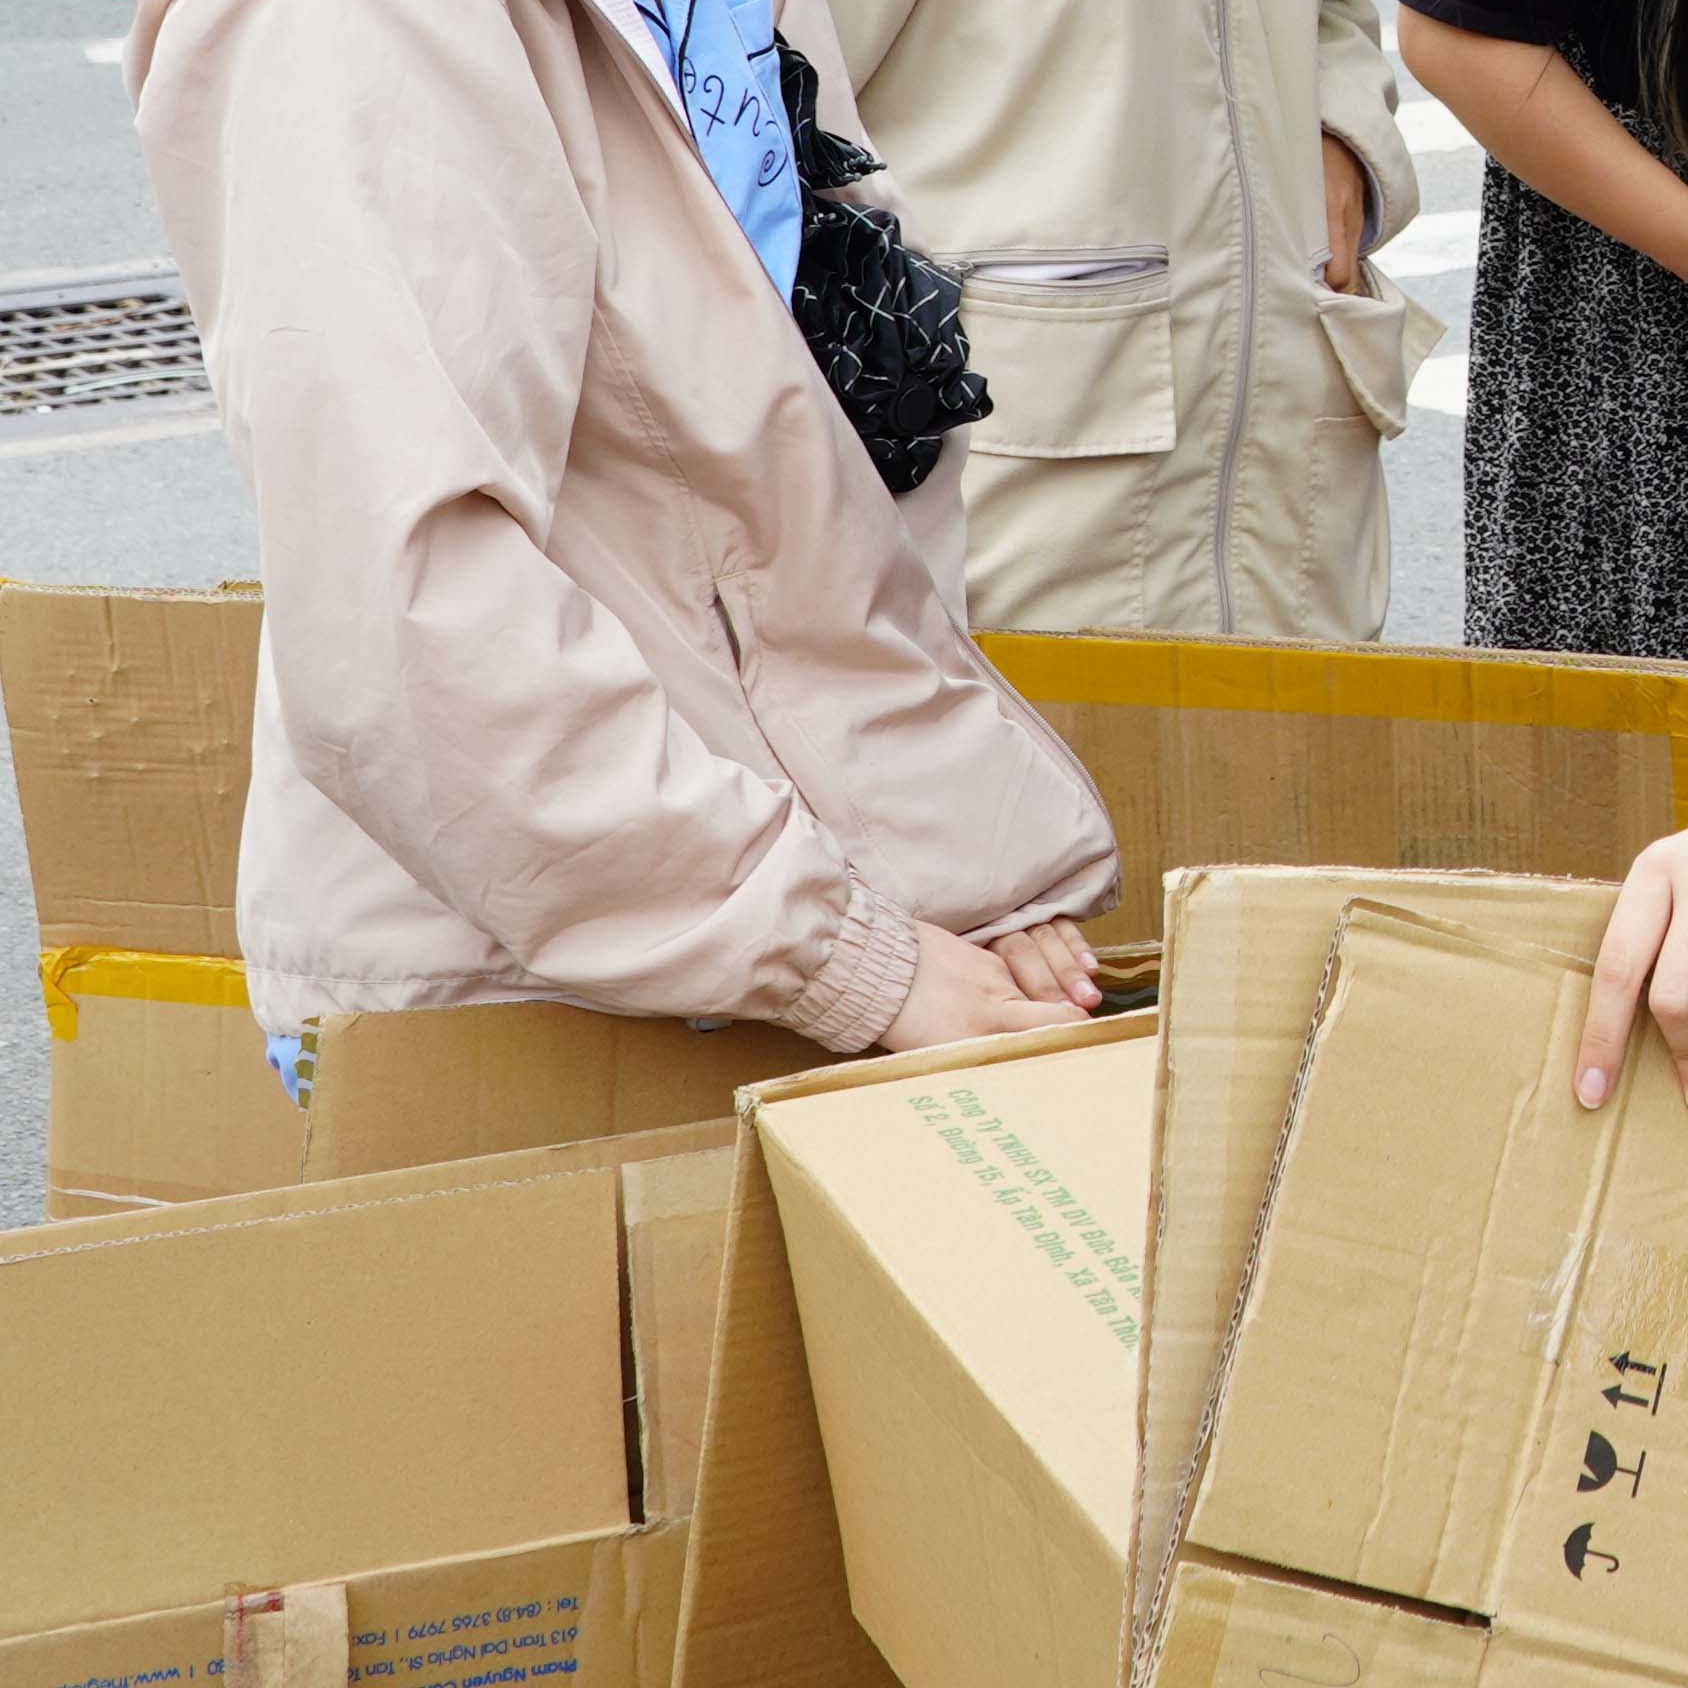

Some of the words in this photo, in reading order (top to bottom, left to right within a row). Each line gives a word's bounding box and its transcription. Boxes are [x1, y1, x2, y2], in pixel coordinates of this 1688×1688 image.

[991, 1132, 1041, 1167] TNHH
[496, 1601, 542, 1623] (84.8)
[556, 1596, 579, 1611] Tel
[408, 1620, 446, 1640] 7979
[452, 1612, 490, 1632] 3765
[352, 1632, 386, 1646] Fax:
[513, 1632, 547, 1648] Tran
[551, 1626, 578, 1644] 613
[366, 1665, 395, 1678] Tan
[532, 1659, 577, 1676] Pham
[463, 1667, 526, 1688] Nguyen
